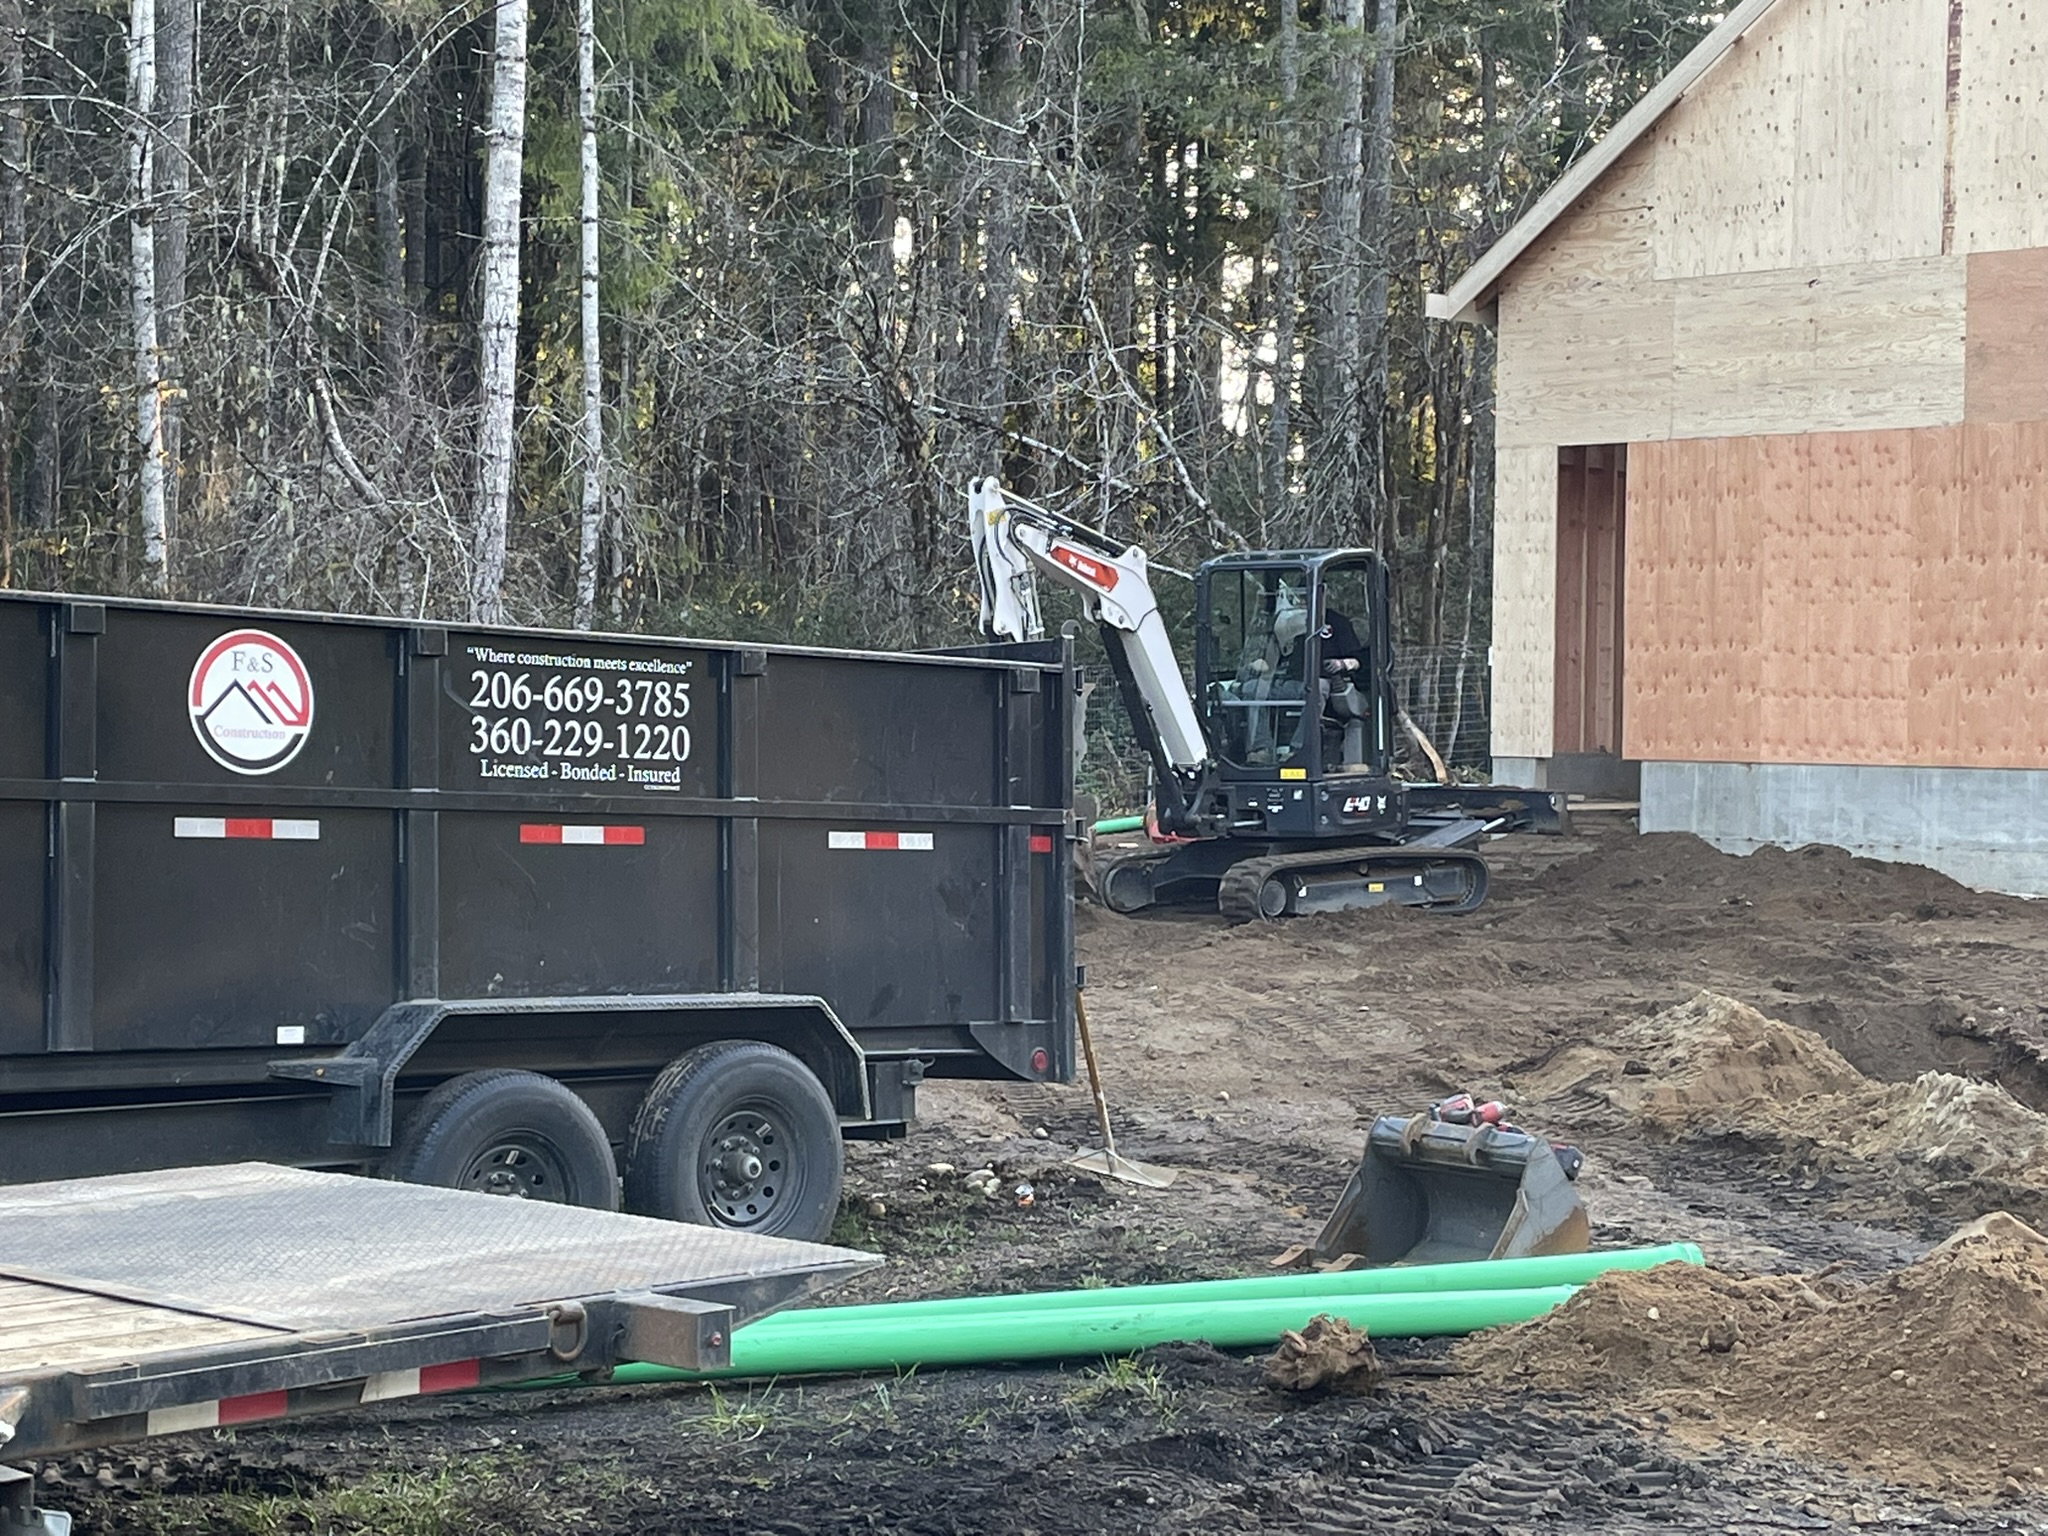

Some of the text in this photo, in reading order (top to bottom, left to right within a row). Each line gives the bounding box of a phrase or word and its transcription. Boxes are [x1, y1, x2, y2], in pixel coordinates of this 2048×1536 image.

[517, 653, 591, 668] construction
[593, 658, 627, 671] meets
[469, 669, 691, 718] 206-669-3785
[213, 724, 286, 740] Construction
[469, 714, 691, 761] 360-229-1220
[480, 759, 549, 779] Licensed
[560, 762, 617, 782] Bonded
[628, 765, 681, 784] Insured
